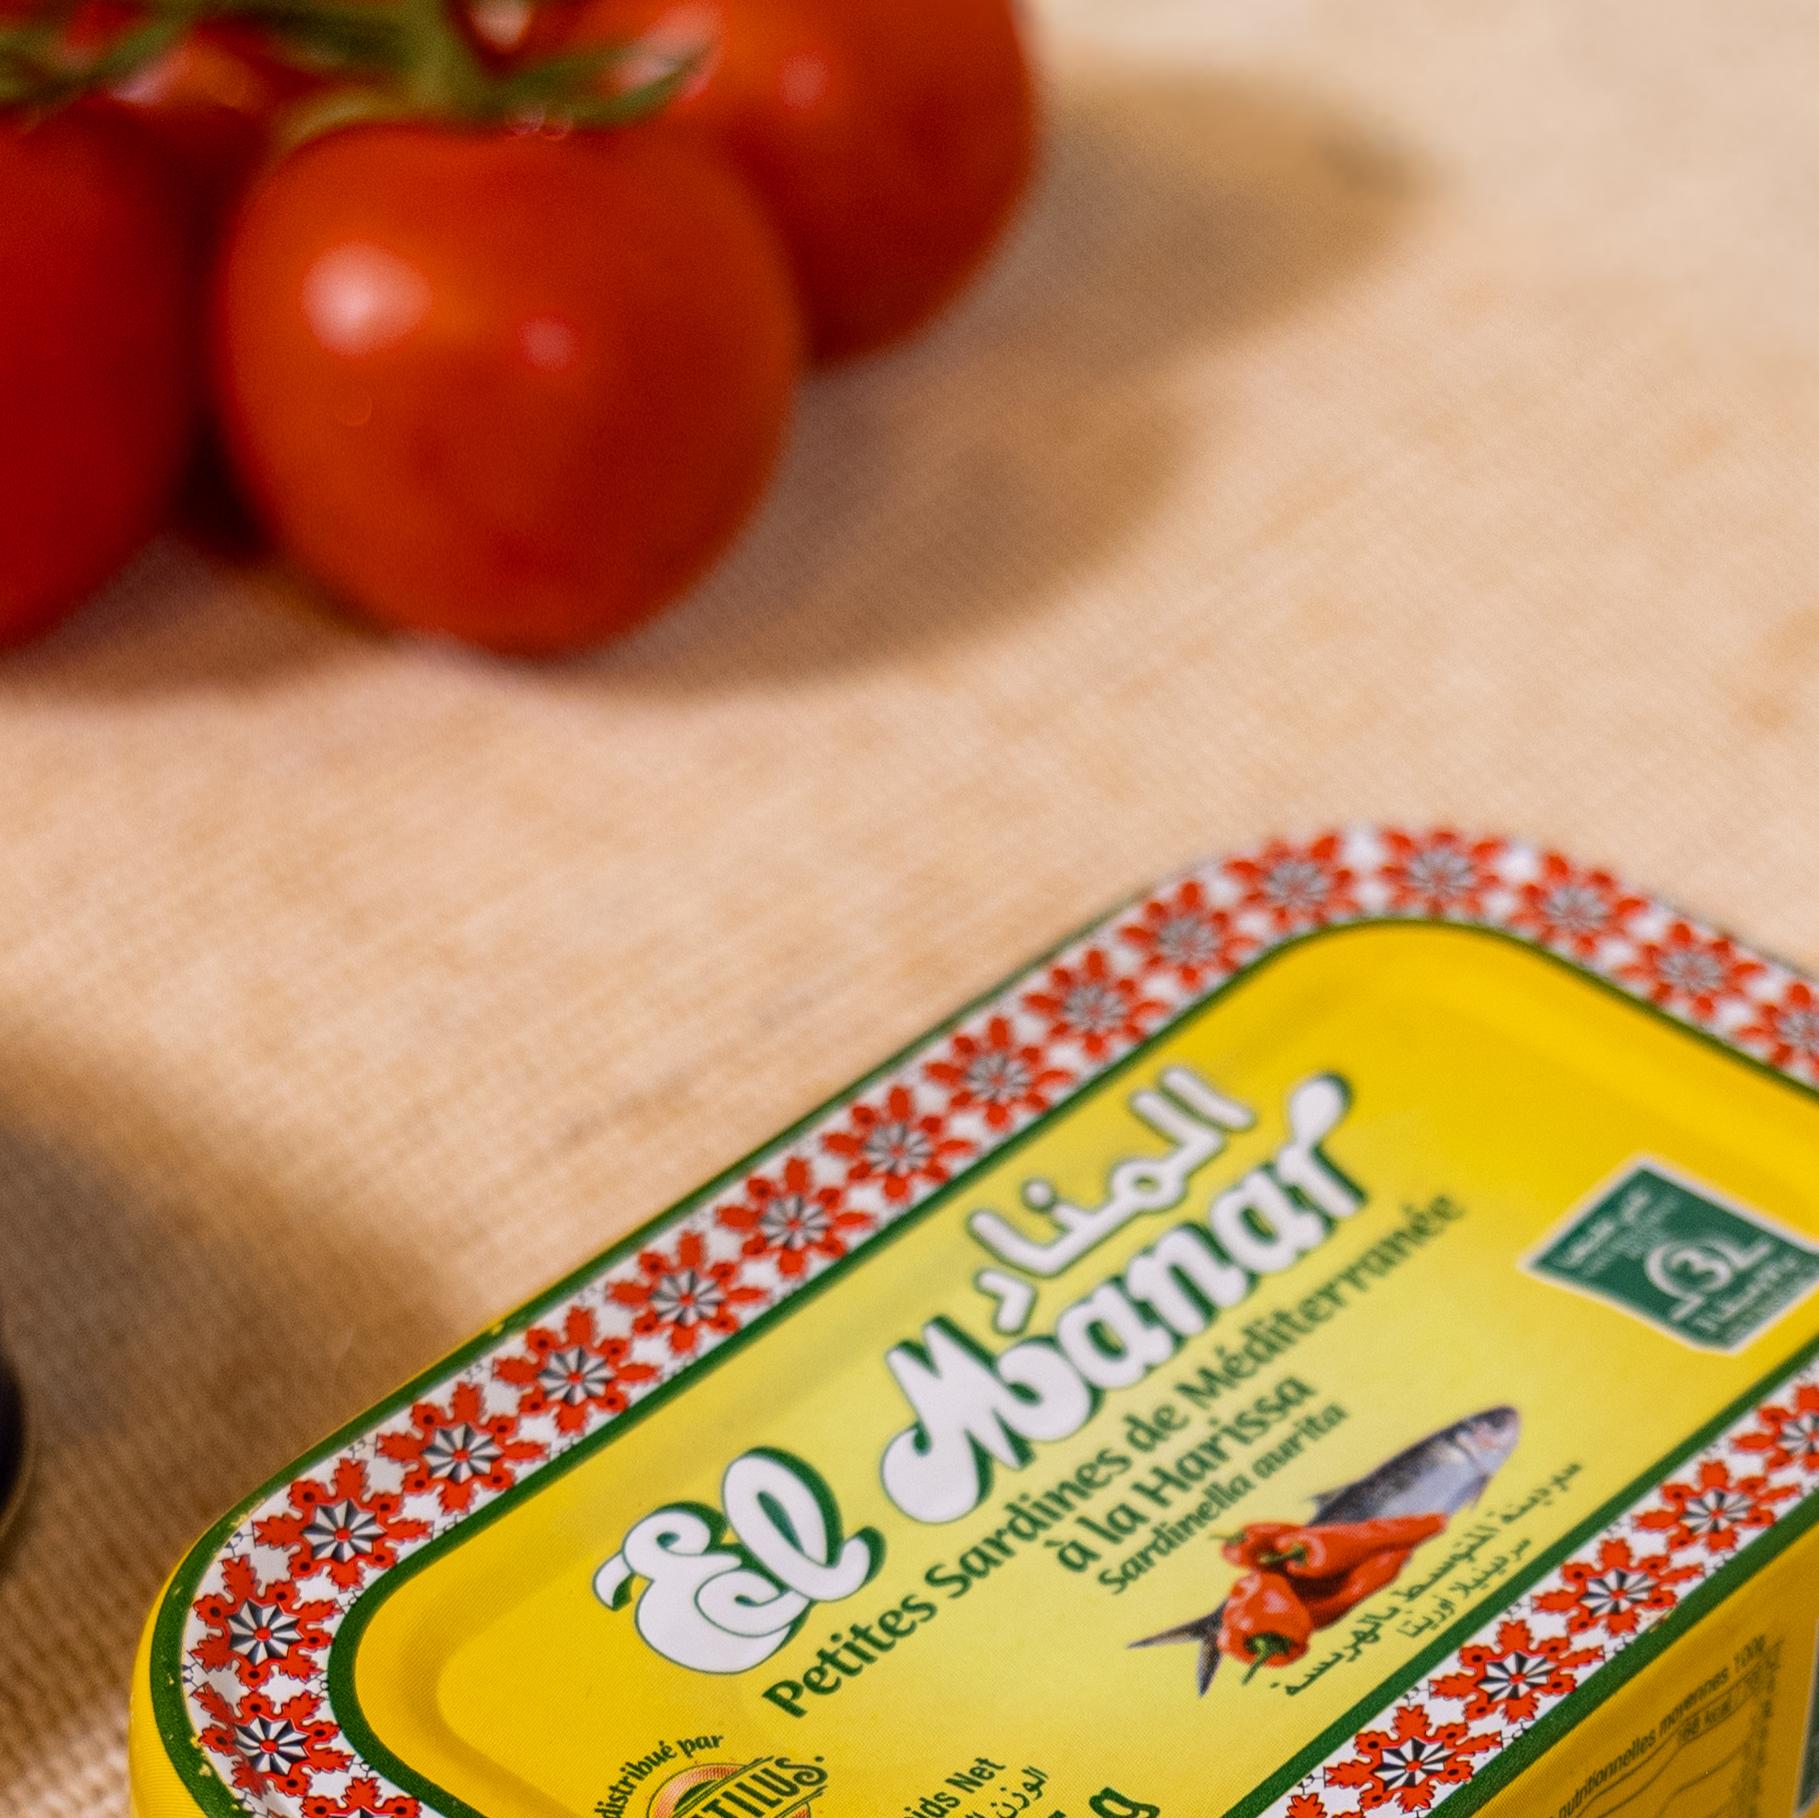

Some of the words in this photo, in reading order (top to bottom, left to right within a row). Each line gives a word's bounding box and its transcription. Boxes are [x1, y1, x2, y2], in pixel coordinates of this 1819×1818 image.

[967, 1063, 1257, 1337] المنار
[761, 1588, 938, 1719] Petites
[923, 1446, 1132, 1601] Sardines
[1121, 1396, 1189, 1456] de
[1173, 1190, 1468, 1415] Méditerranée
[1044, 1537, 1094, 1578] à
[1084, 1499, 1137, 1548] la
[1131, 1370, 1319, 1509] Harissa
[1097, 1473, 1255, 1595] Sardinella
[1250, 1401, 1351, 1481] aurita
[591, 1446, 886, 1675] El
[676, 1732, 724, 1760] par
[945, 1755, 1007, 1810] Net
